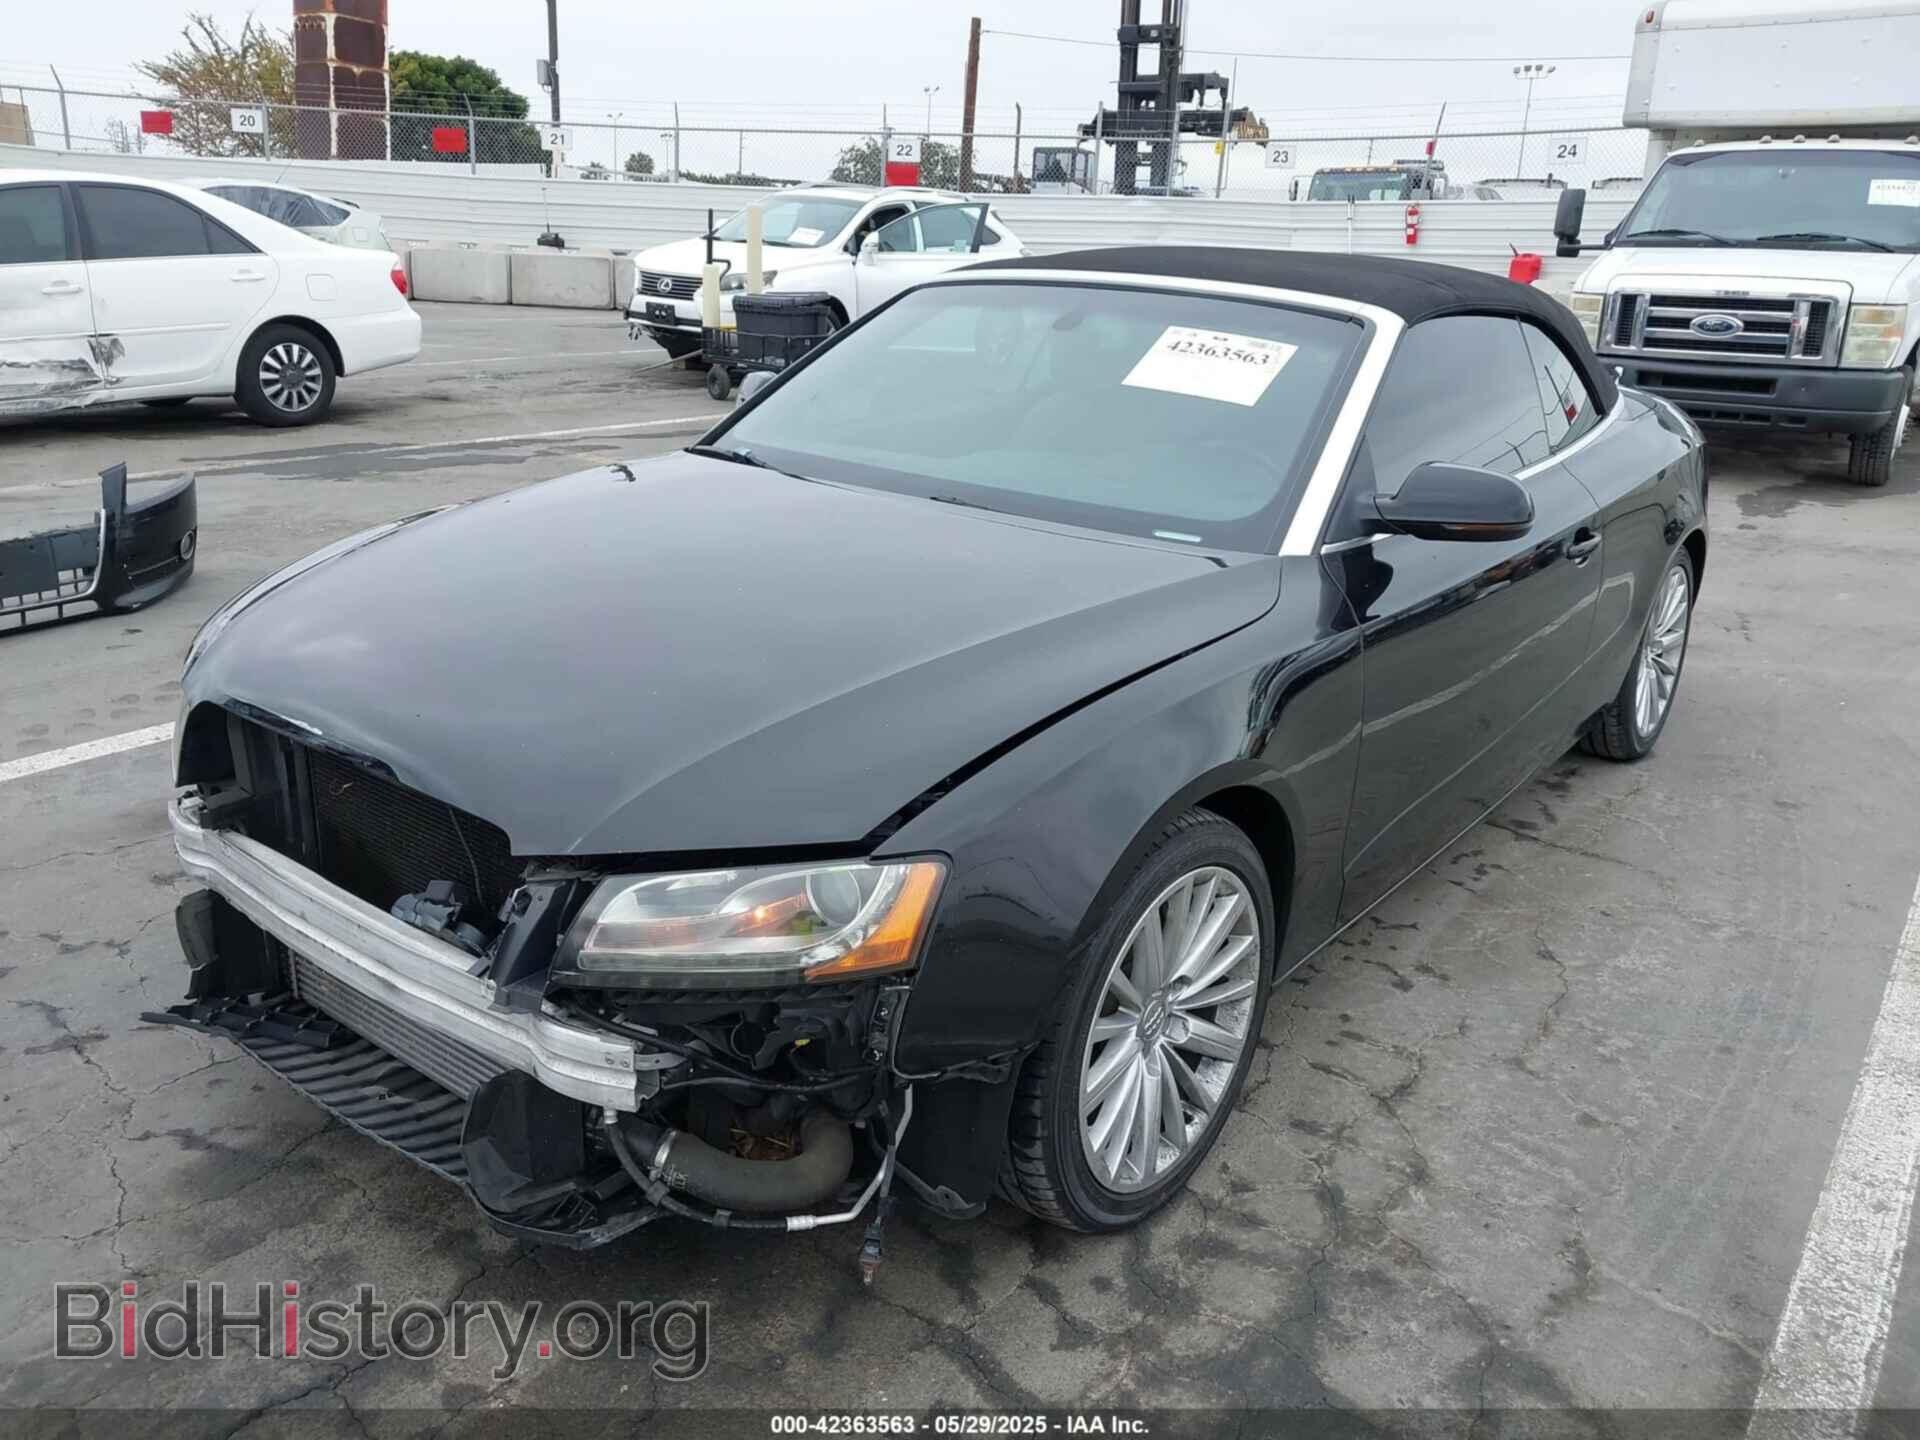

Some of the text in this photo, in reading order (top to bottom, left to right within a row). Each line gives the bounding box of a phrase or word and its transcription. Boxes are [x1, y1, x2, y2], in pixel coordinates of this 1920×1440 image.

[239, 114, 256, 127] 20
[550, 133, 565, 145] 21
[896, 144, 913, 157] 22
[1272, 150, 1289, 163] 23
[1557, 144, 1577, 158] 24
[1167, 340, 1270, 366] 42363563
